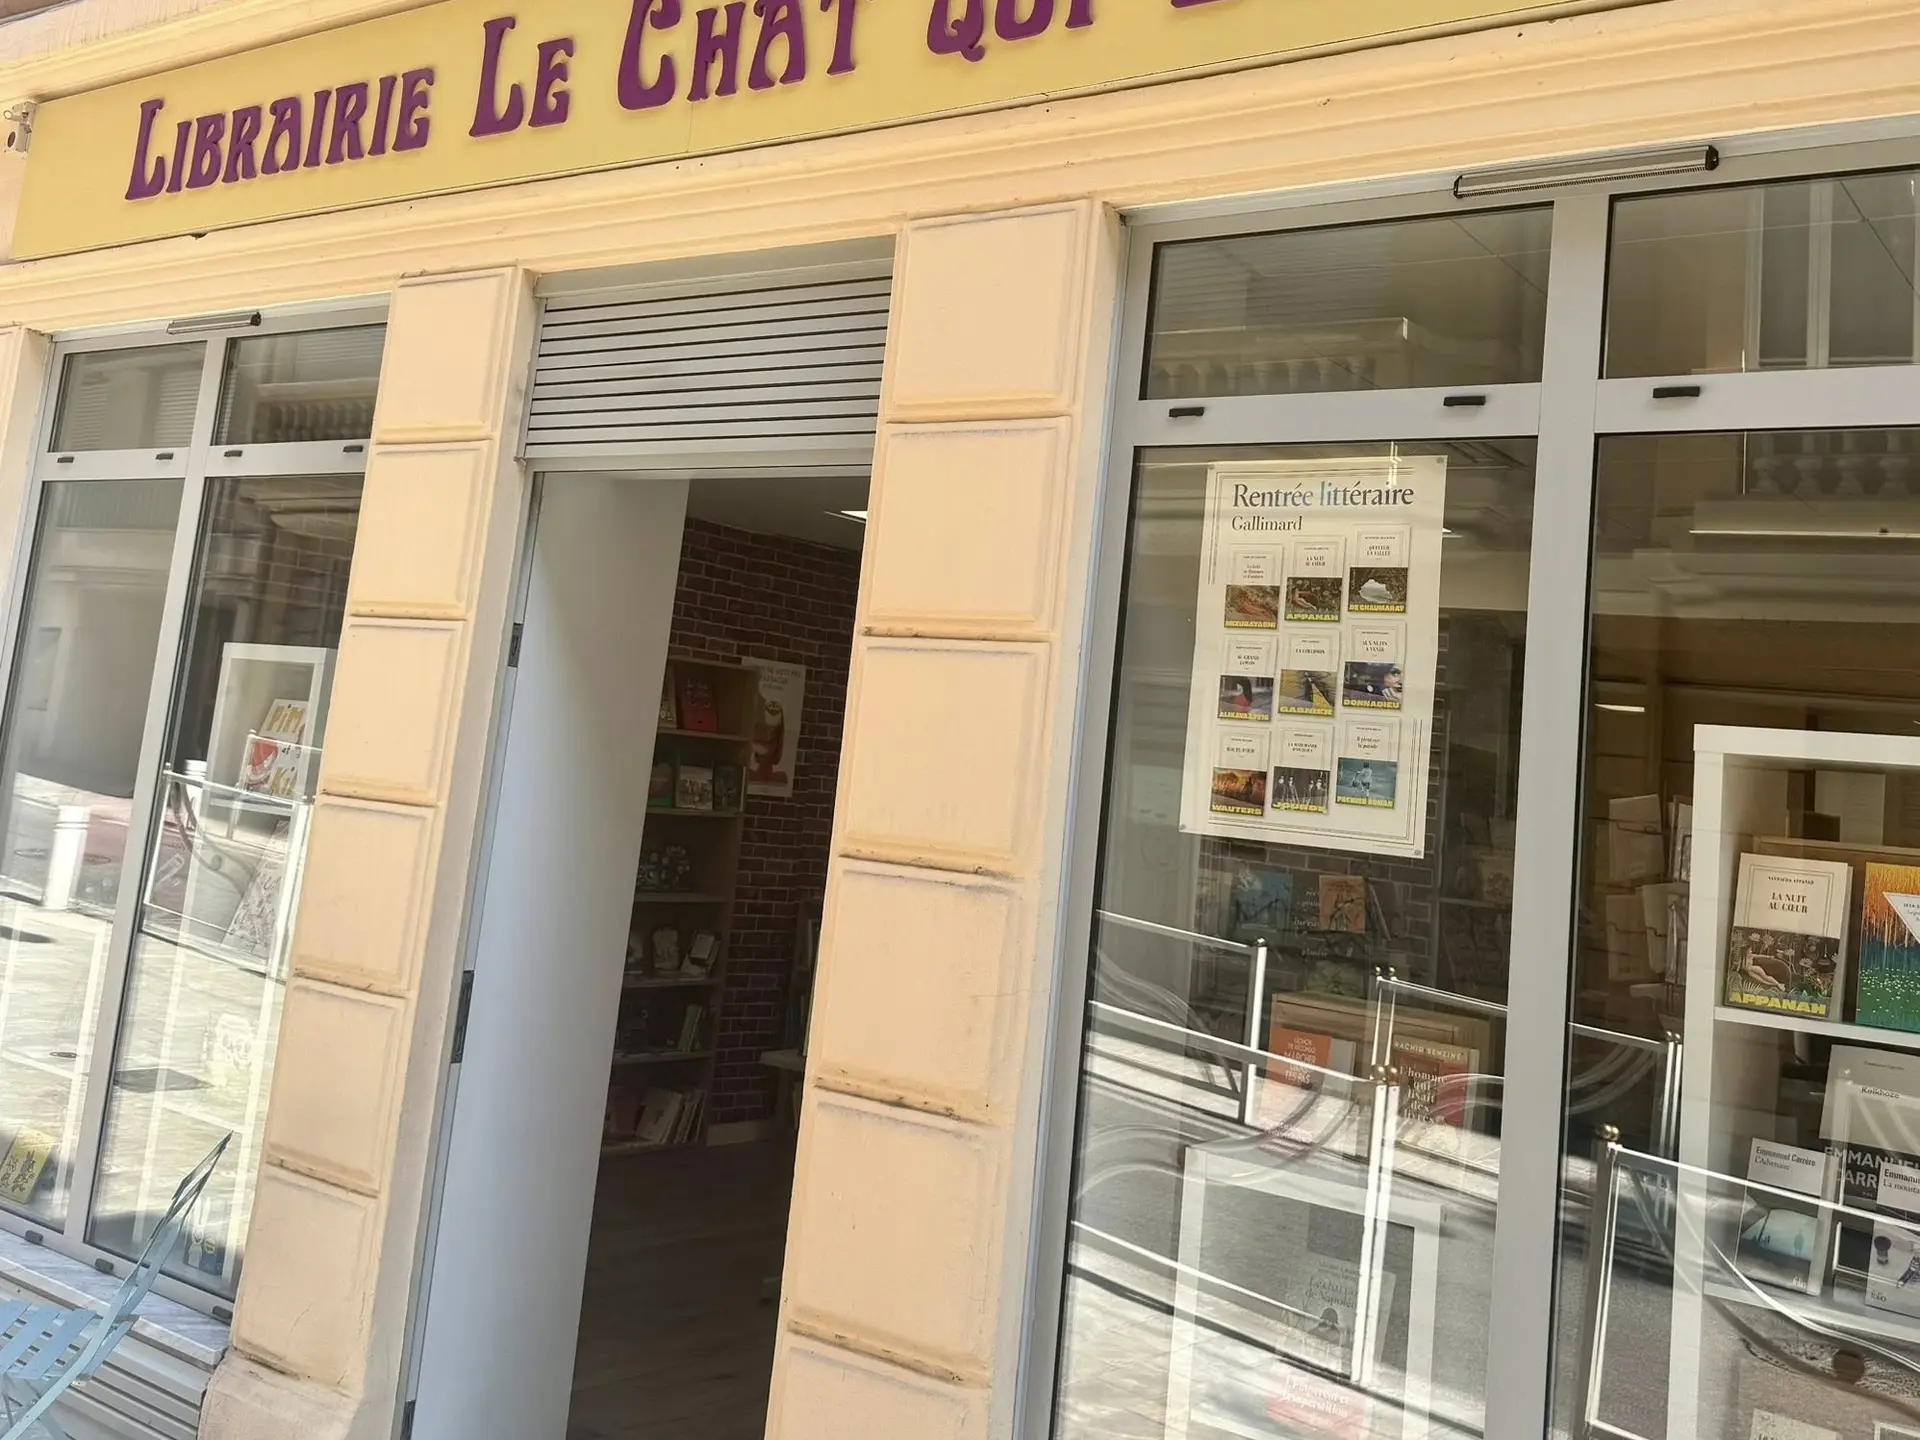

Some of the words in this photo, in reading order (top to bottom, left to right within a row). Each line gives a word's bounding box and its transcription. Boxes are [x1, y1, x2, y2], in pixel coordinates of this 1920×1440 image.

[125, 66, 435, 201] LIBRAIRIE
[469, 16, 575, 138] LE
[616, 0, 858, 111] CHAT
[1233, 483, 1314, 508] Rentrée
[1319, 480, 1415, 508] littéraire
[1231, 516, 1303, 531] Gallimard
[1285, 613, 1339, 621] APPANAH
[1343, 699, 1400, 709] DONNADIEU
[1211, 804, 1263, 815] WAUTERS
[1772, 892, 1783, 900] LA
[1786, 894, 1807, 904] NUIT
[1768, 902, 1780, 910] AU
[1729, 991, 1827, 1015] APPANAH
[1394, 1041, 1424, 1052] RACHID
[1792, 1154, 1816, 1167] Carrère
